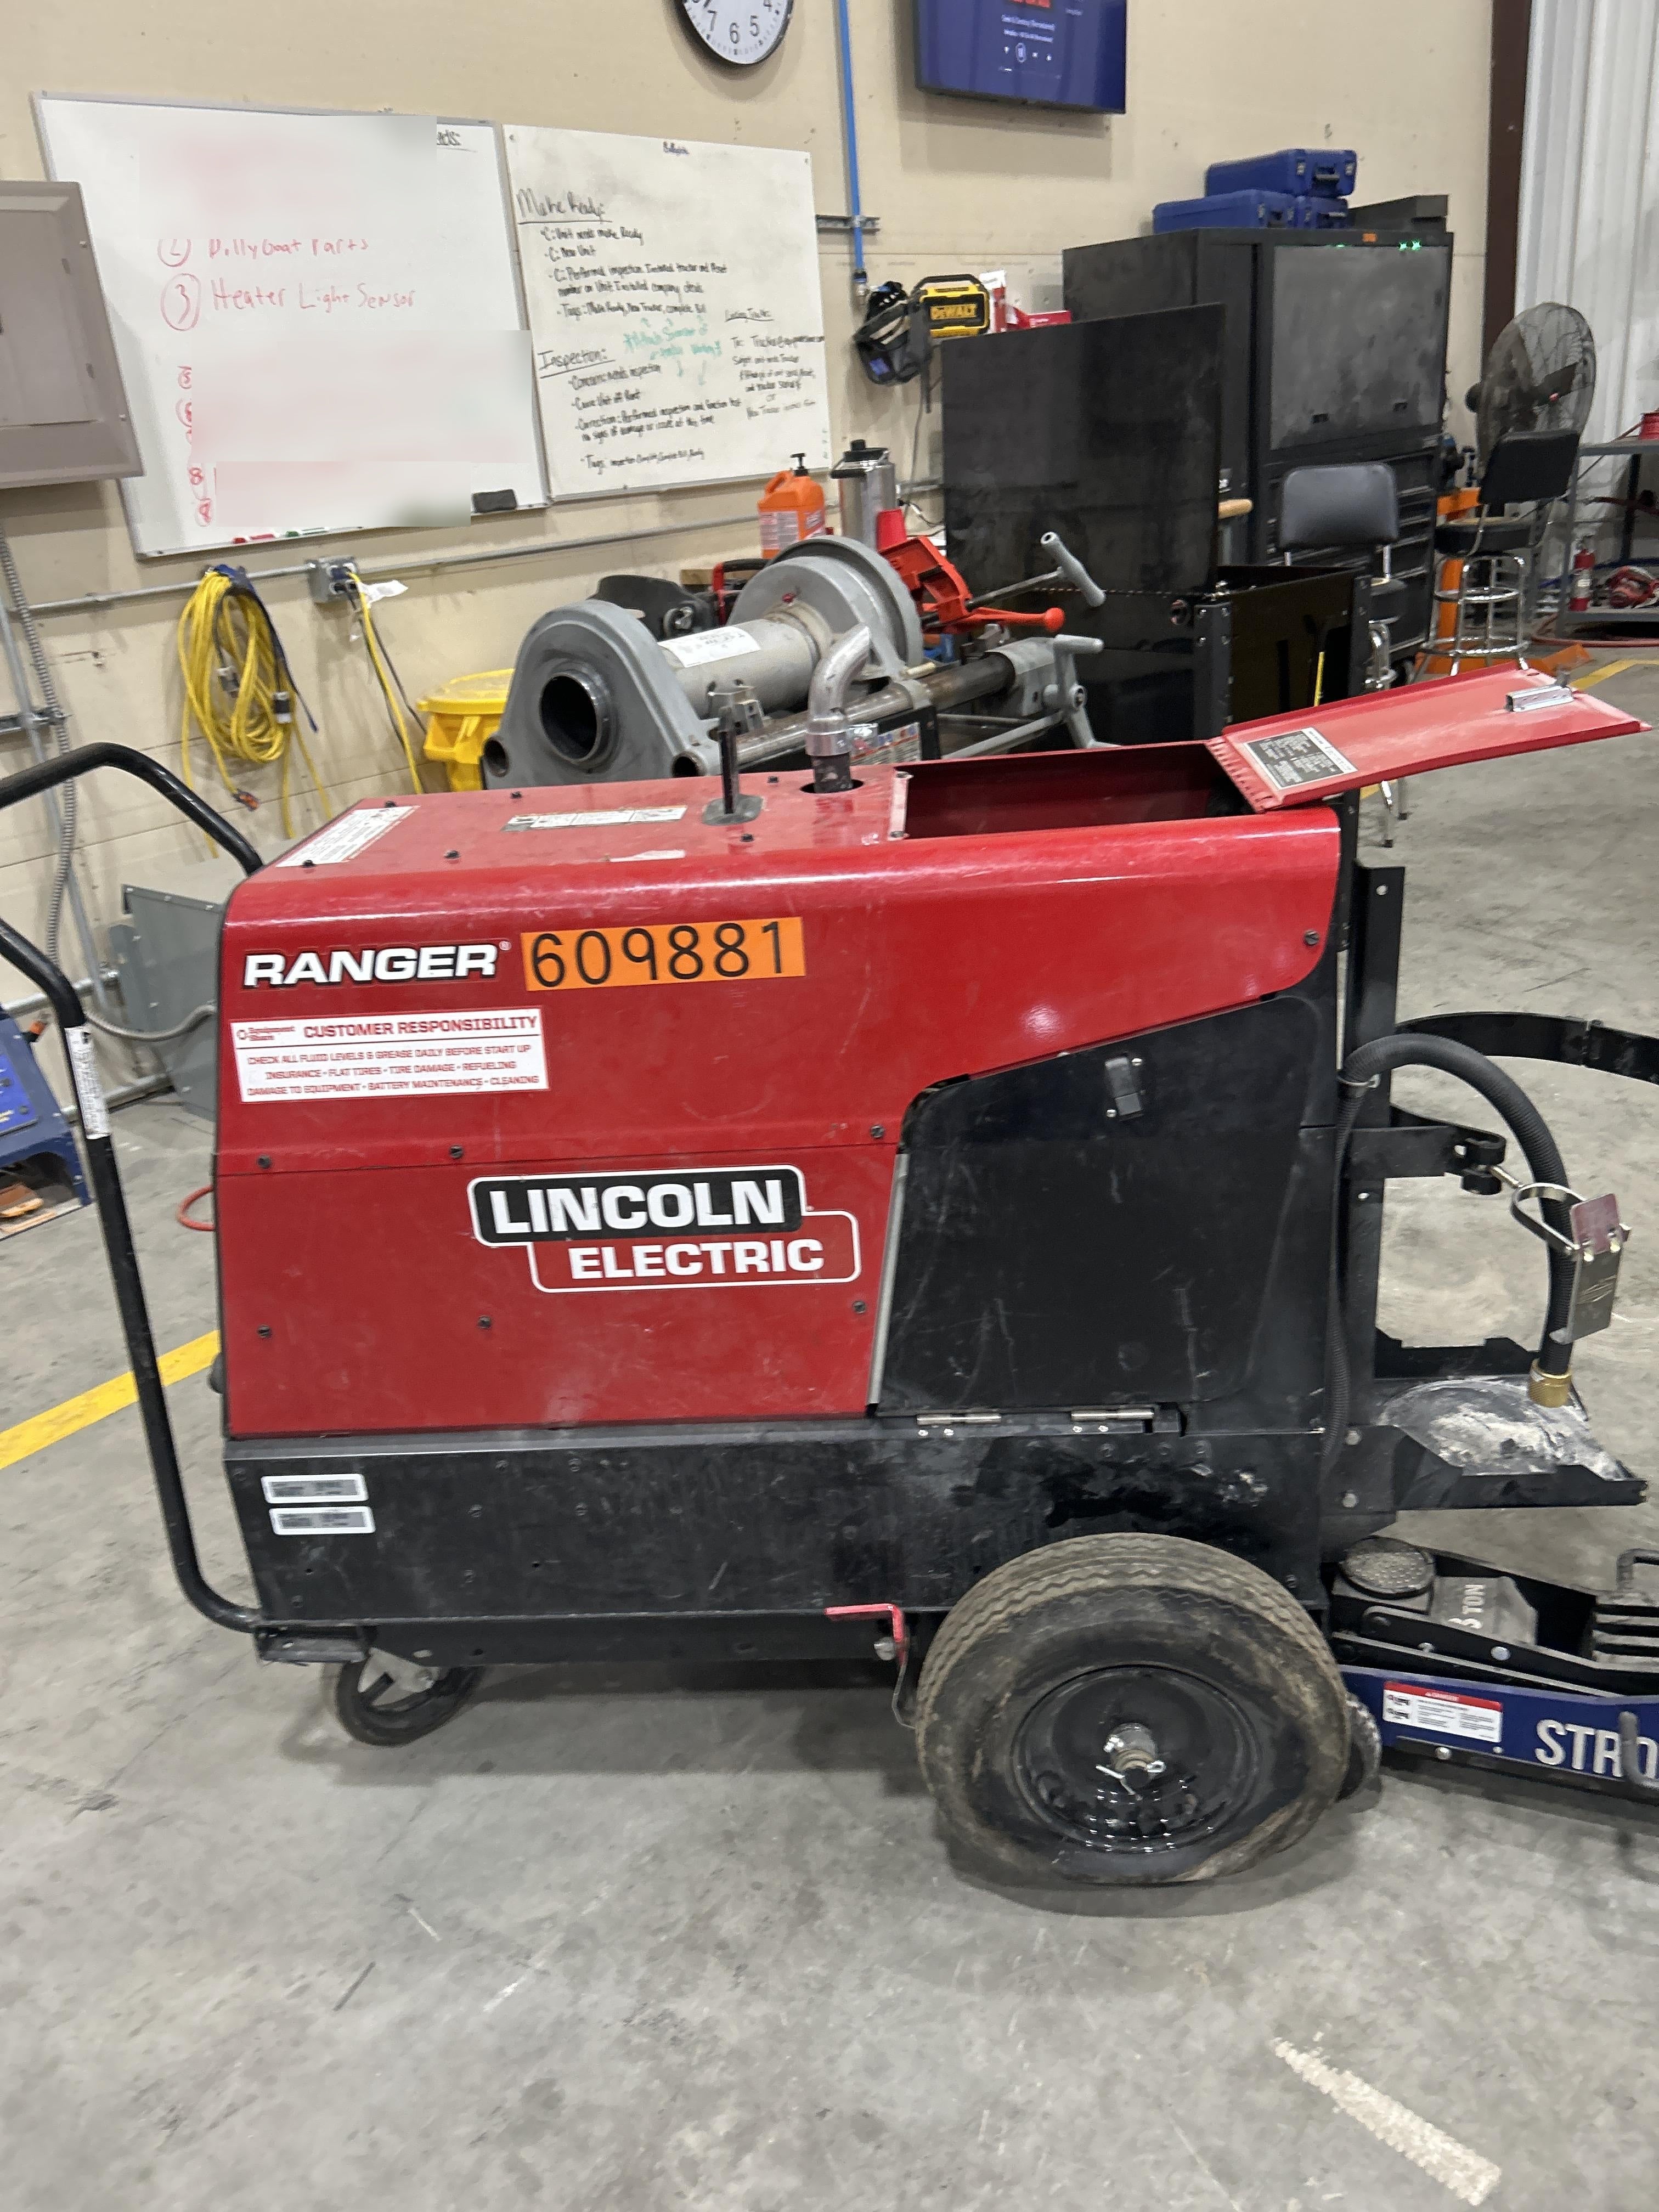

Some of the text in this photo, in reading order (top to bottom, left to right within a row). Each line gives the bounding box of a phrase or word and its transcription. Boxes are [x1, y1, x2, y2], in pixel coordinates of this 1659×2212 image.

[707, 10, 717, 31] 7
[749, 15, 760, 36] 5
[729, 22, 740, 44] 6
[210, 277, 285, 311] Heater
[299, 282, 349, 313] Light
[357, 282, 416, 309] Sensor
[244, 943, 498, 987] RANGER
[531, 920, 782, 988] 609881
[303, 1015, 538, 1039] CUSTOMER RESPONSIBILITY
[247, 1056, 280, 1065] CHECK
[282, 1055, 299, 1063] ALL
[300, 1053, 329, 1063] FLUID
[330, 1052, 365, 1062] LEVELS
[376, 1049, 413, 1059] GREASE
[415, 1048, 443, 1058] DAILY
[445, 1047, 483, 1056] BEFORE
[484, 1045, 516, 1054] START
[517, 1044, 531, 1053] UP
[265, 1061, 517, 1080] INSURANCE FLAT TIRES TIRE DAMAGE REFUELING
[247, 1075, 540, 1096] DAMAGE TO EQUIPMENT BATTERY MAINTENANCE CLEANING
[489, 1179, 785, 1234] LINCOLN
[568, 1238, 825, 1279] ELECTRIC
[1462, 1584, 1486, 1615] TON
